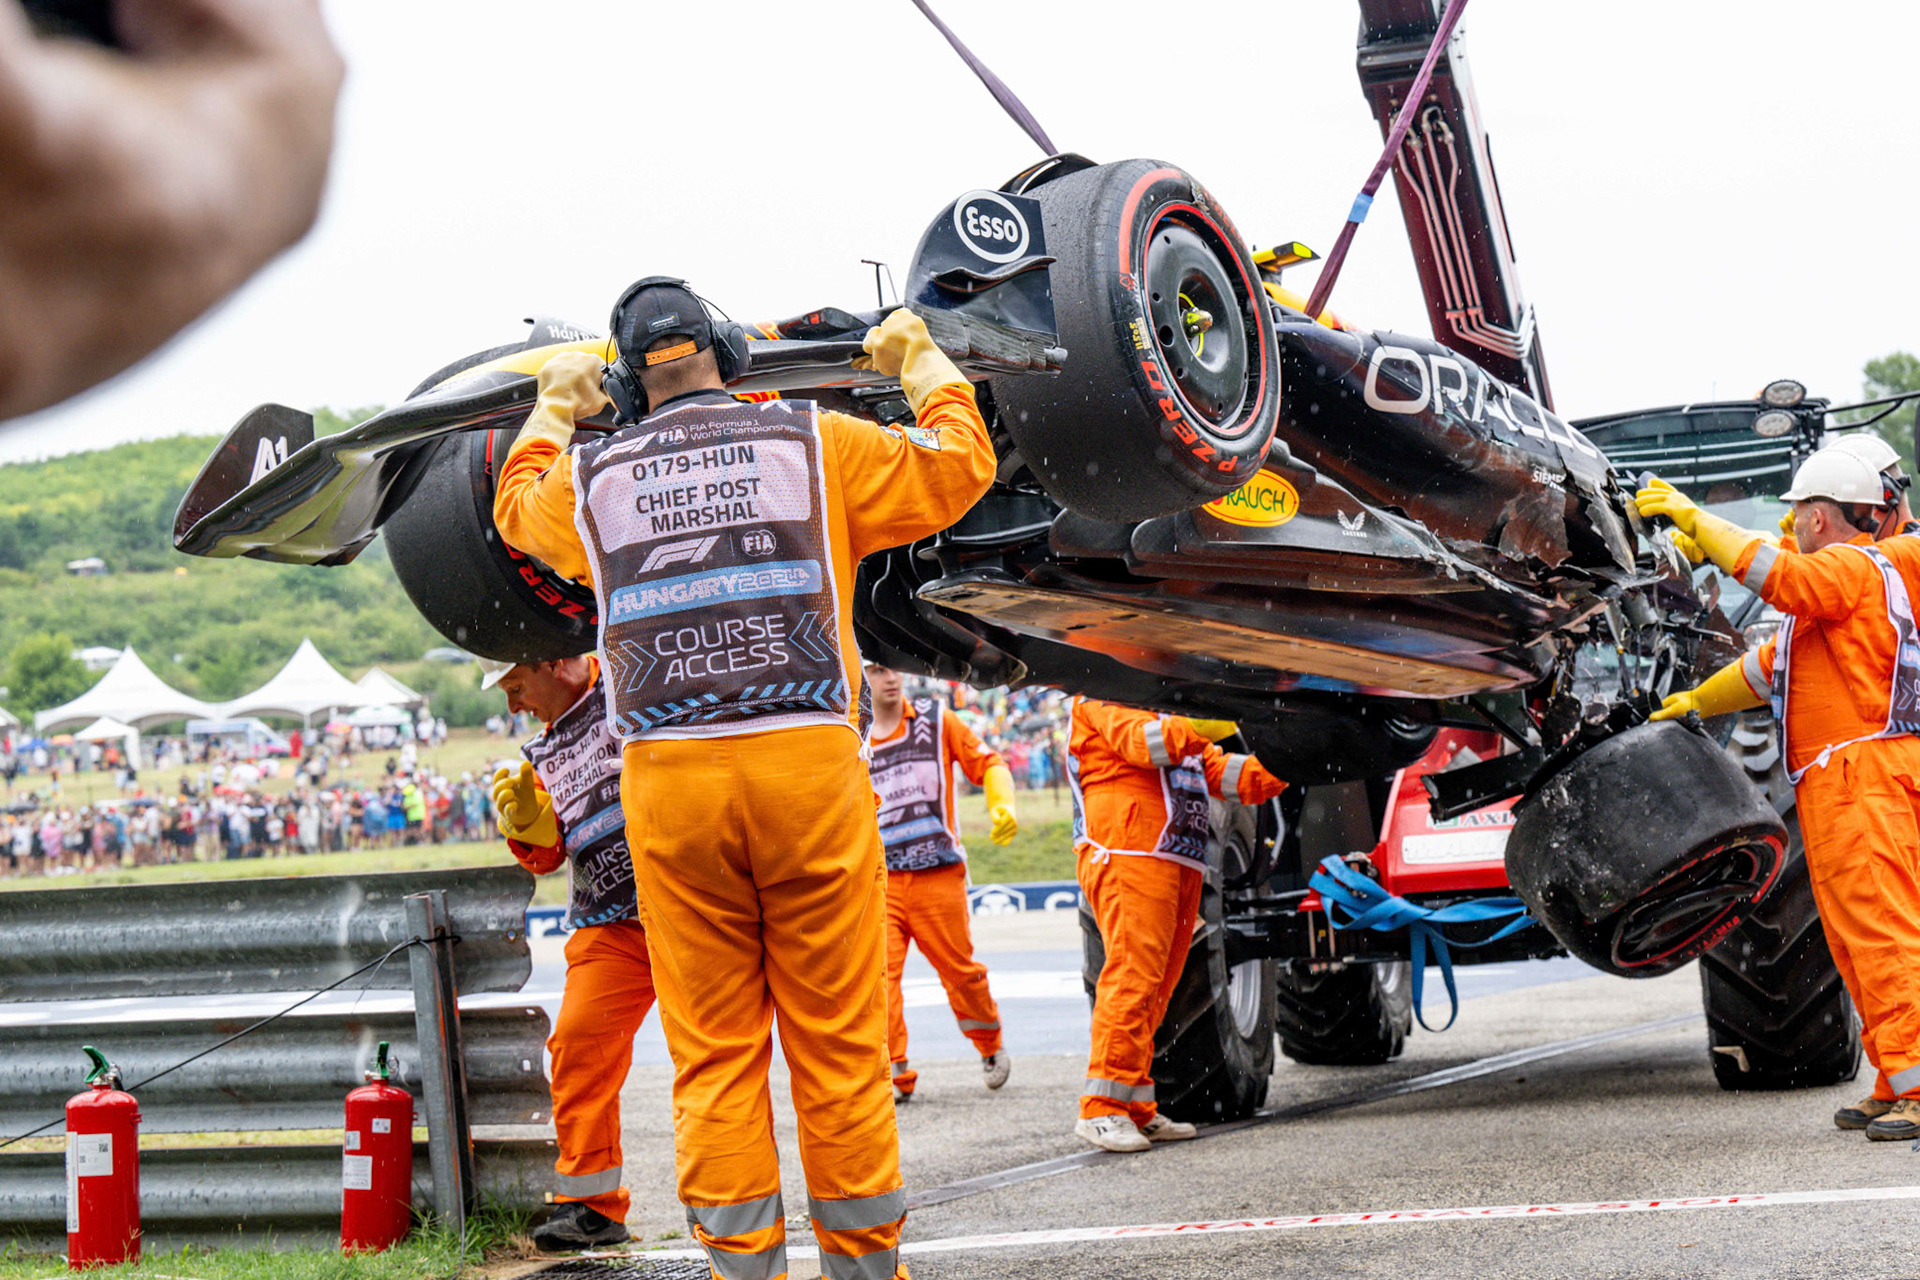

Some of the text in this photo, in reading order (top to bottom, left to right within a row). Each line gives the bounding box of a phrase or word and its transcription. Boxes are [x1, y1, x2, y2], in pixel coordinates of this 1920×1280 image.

[689, 418, 761, 433] FIA Formula 1
[1140, 360, 1218, 463] ZERO
[657, 427, 685, 445] FIA
[690, 423, 798, 441] World Championship
[632, 444, 756, 482] 0179-HUN
[635, 476, 761, 514] CHIEF POST
[650, 500, 760, 534] MARSHAL
[742, 534, 774, 553] FIA
[654, 613, 787, 657] COURSE
[663, 641, 790, 685] ACCESS
